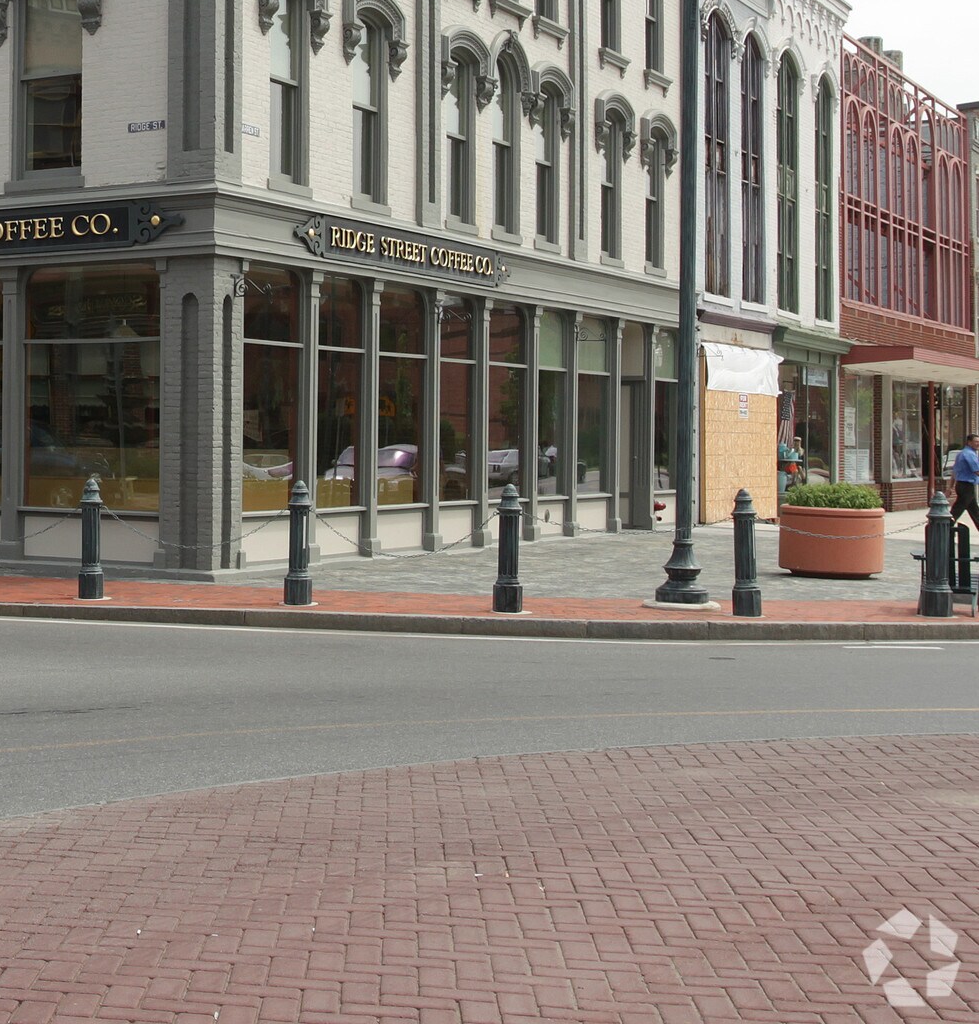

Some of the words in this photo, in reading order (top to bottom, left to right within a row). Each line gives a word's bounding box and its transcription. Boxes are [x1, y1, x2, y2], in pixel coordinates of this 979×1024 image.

[130, 122, 151, 132] RIDGE
[71, 213, 119, 236] CO.
[331, 226, 375, 254] RIDGE
[380, 236, 428, 263] STREET
[430, 246, 474, 272] COFFEE
[475, 255, 494, 276] CO.
